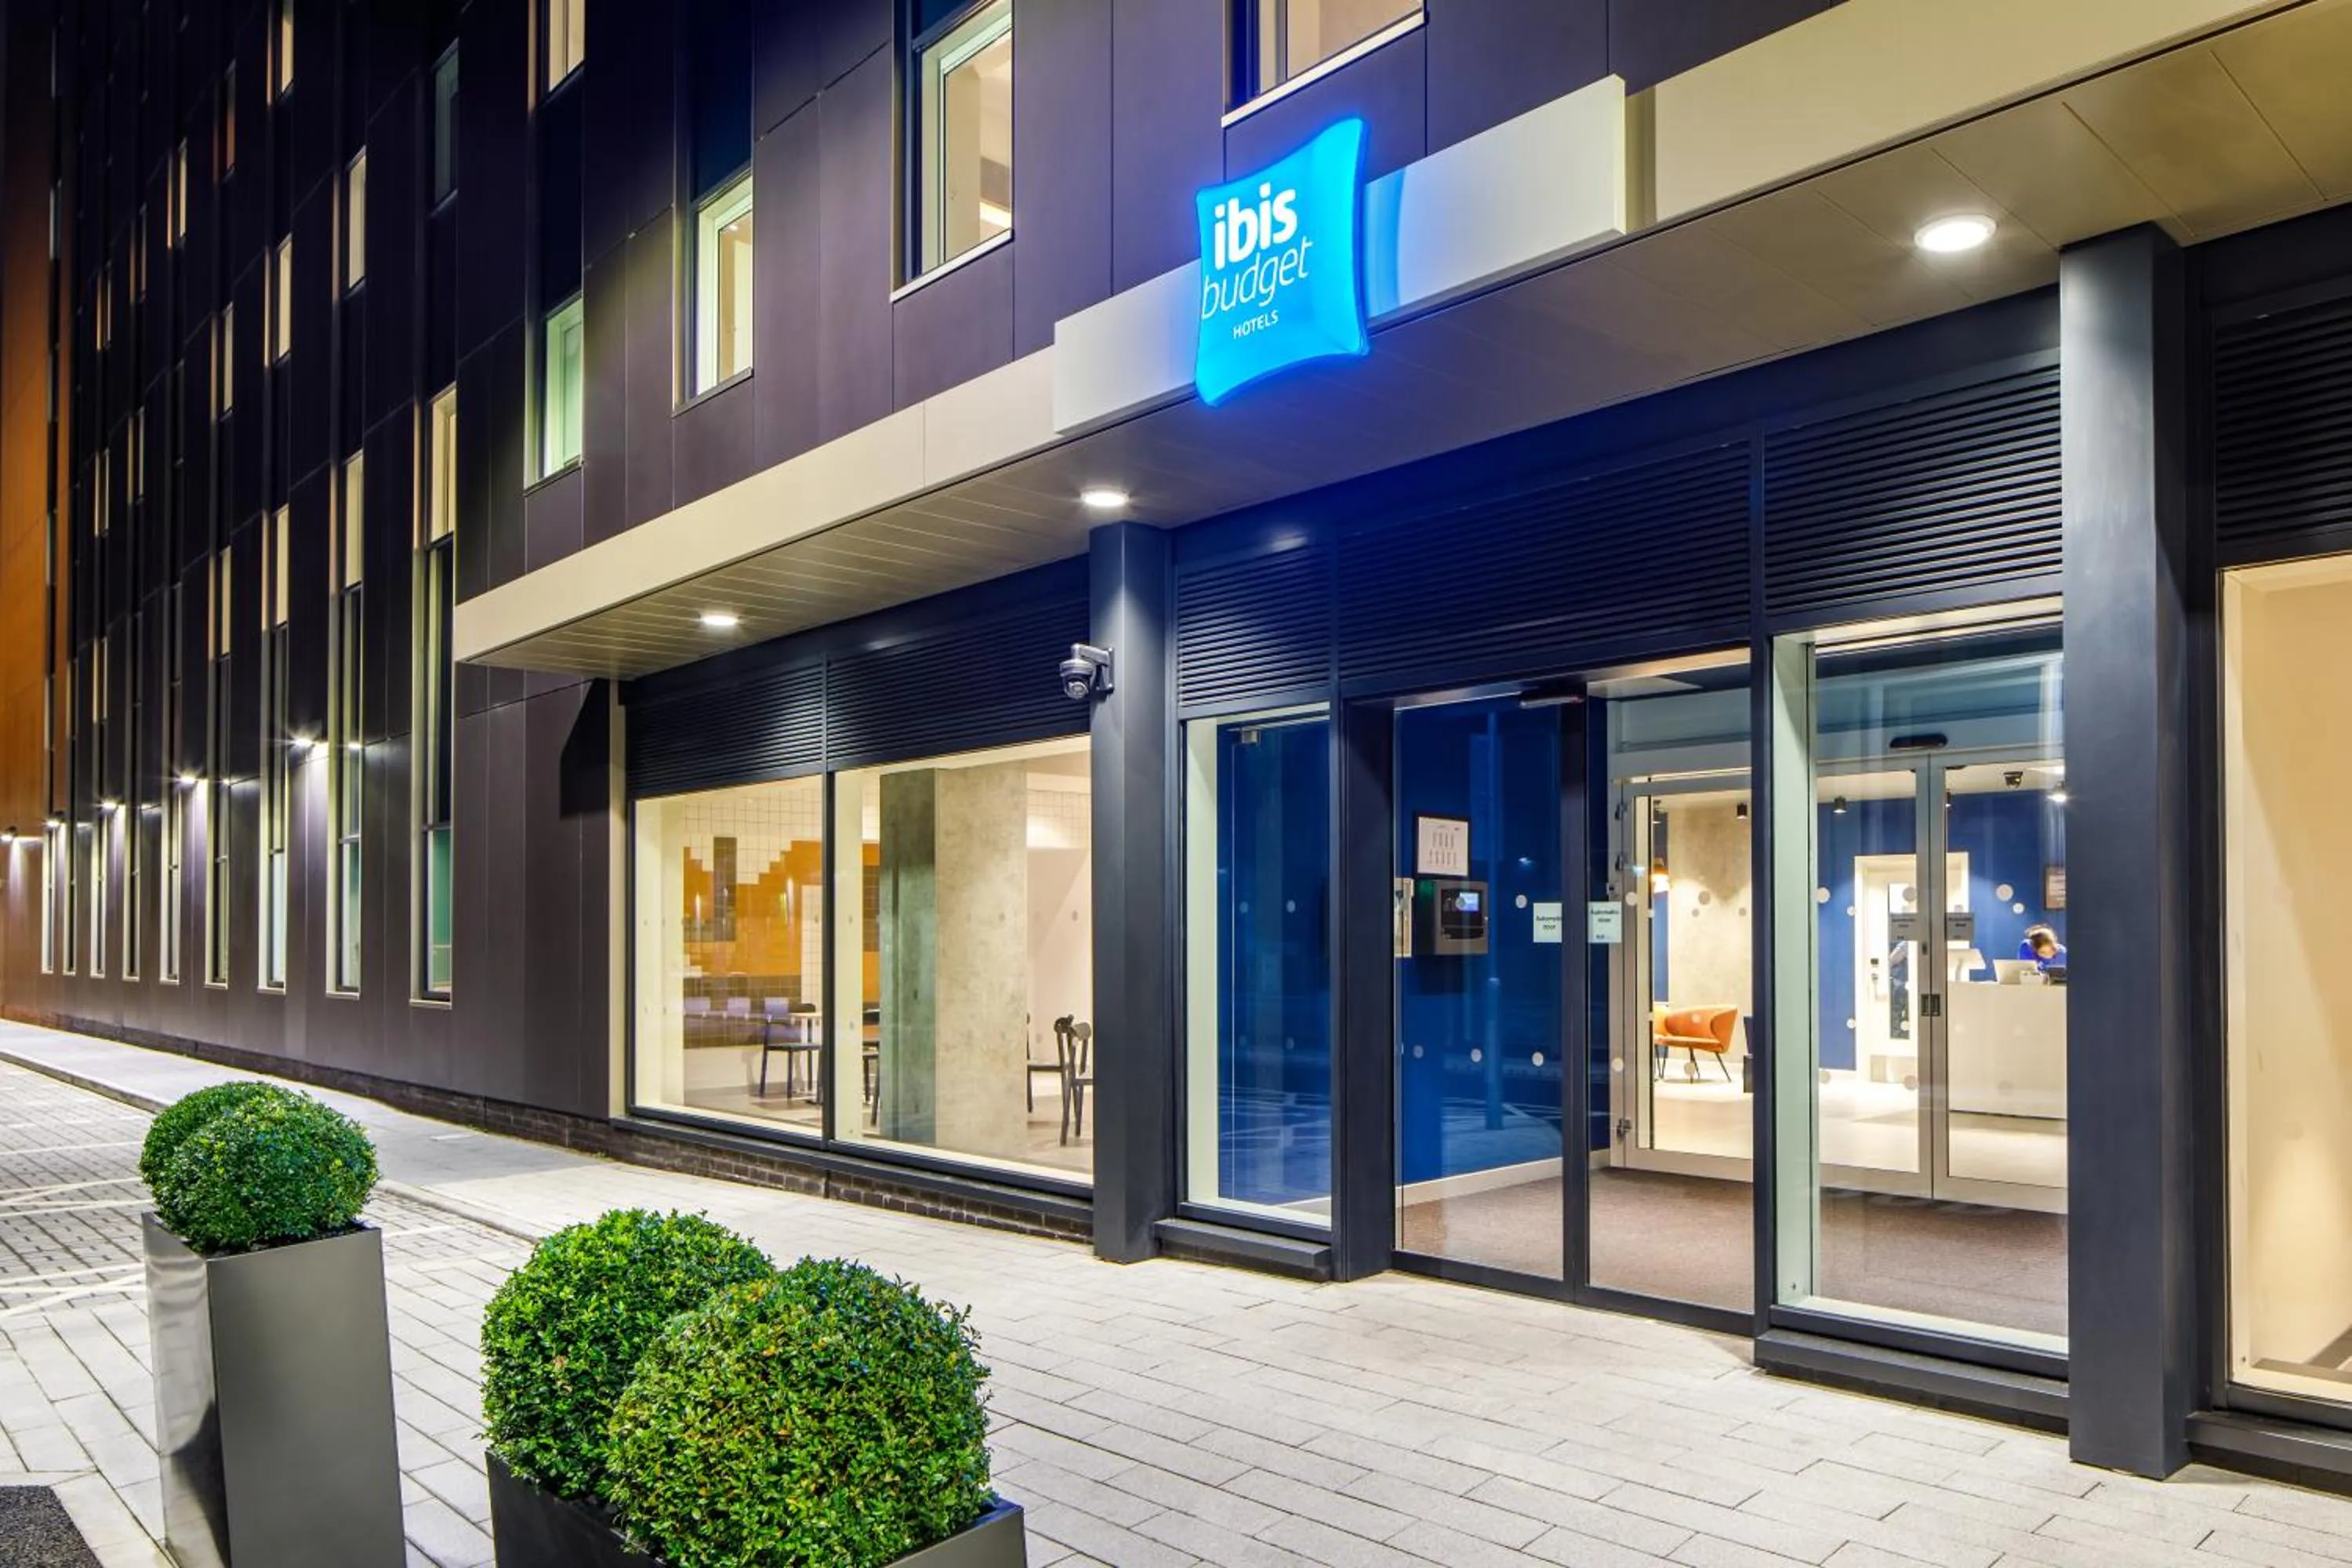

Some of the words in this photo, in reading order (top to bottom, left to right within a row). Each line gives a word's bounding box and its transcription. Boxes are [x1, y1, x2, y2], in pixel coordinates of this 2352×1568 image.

[1214, 181, 1298, 270] ibis
[1201, 235, 1314, 320] budget
[1233, 310, 1279, 339] HOTELS
